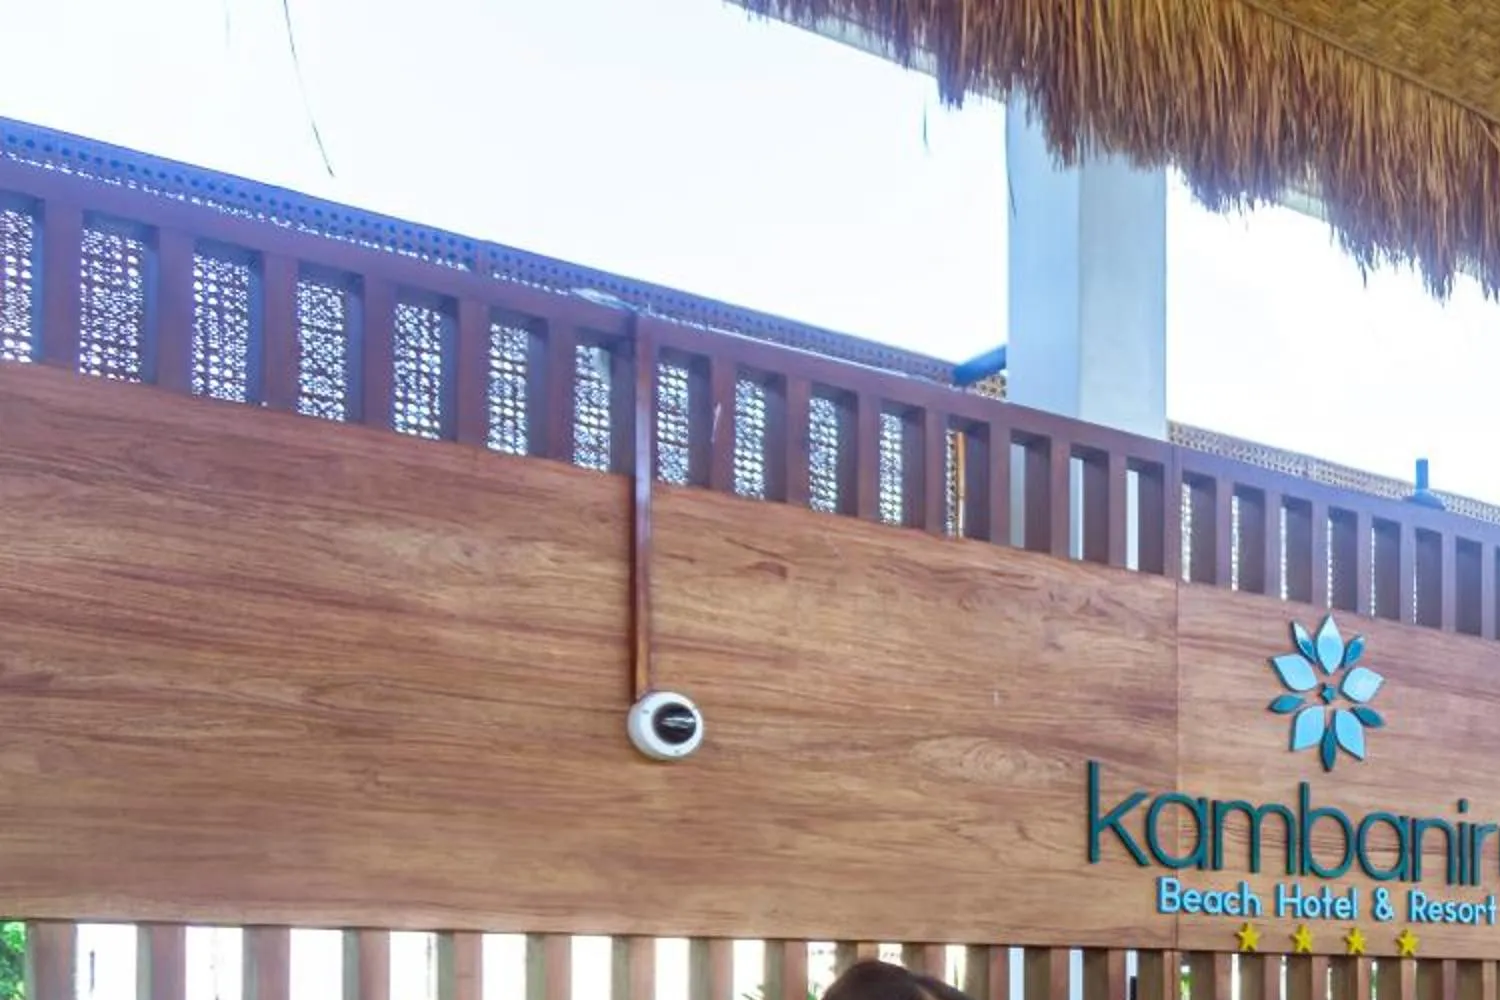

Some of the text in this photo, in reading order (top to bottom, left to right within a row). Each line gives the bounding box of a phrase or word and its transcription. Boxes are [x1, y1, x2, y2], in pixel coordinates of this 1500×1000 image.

[1157, 876, 1498, 925] Beach Hotel & Resort
